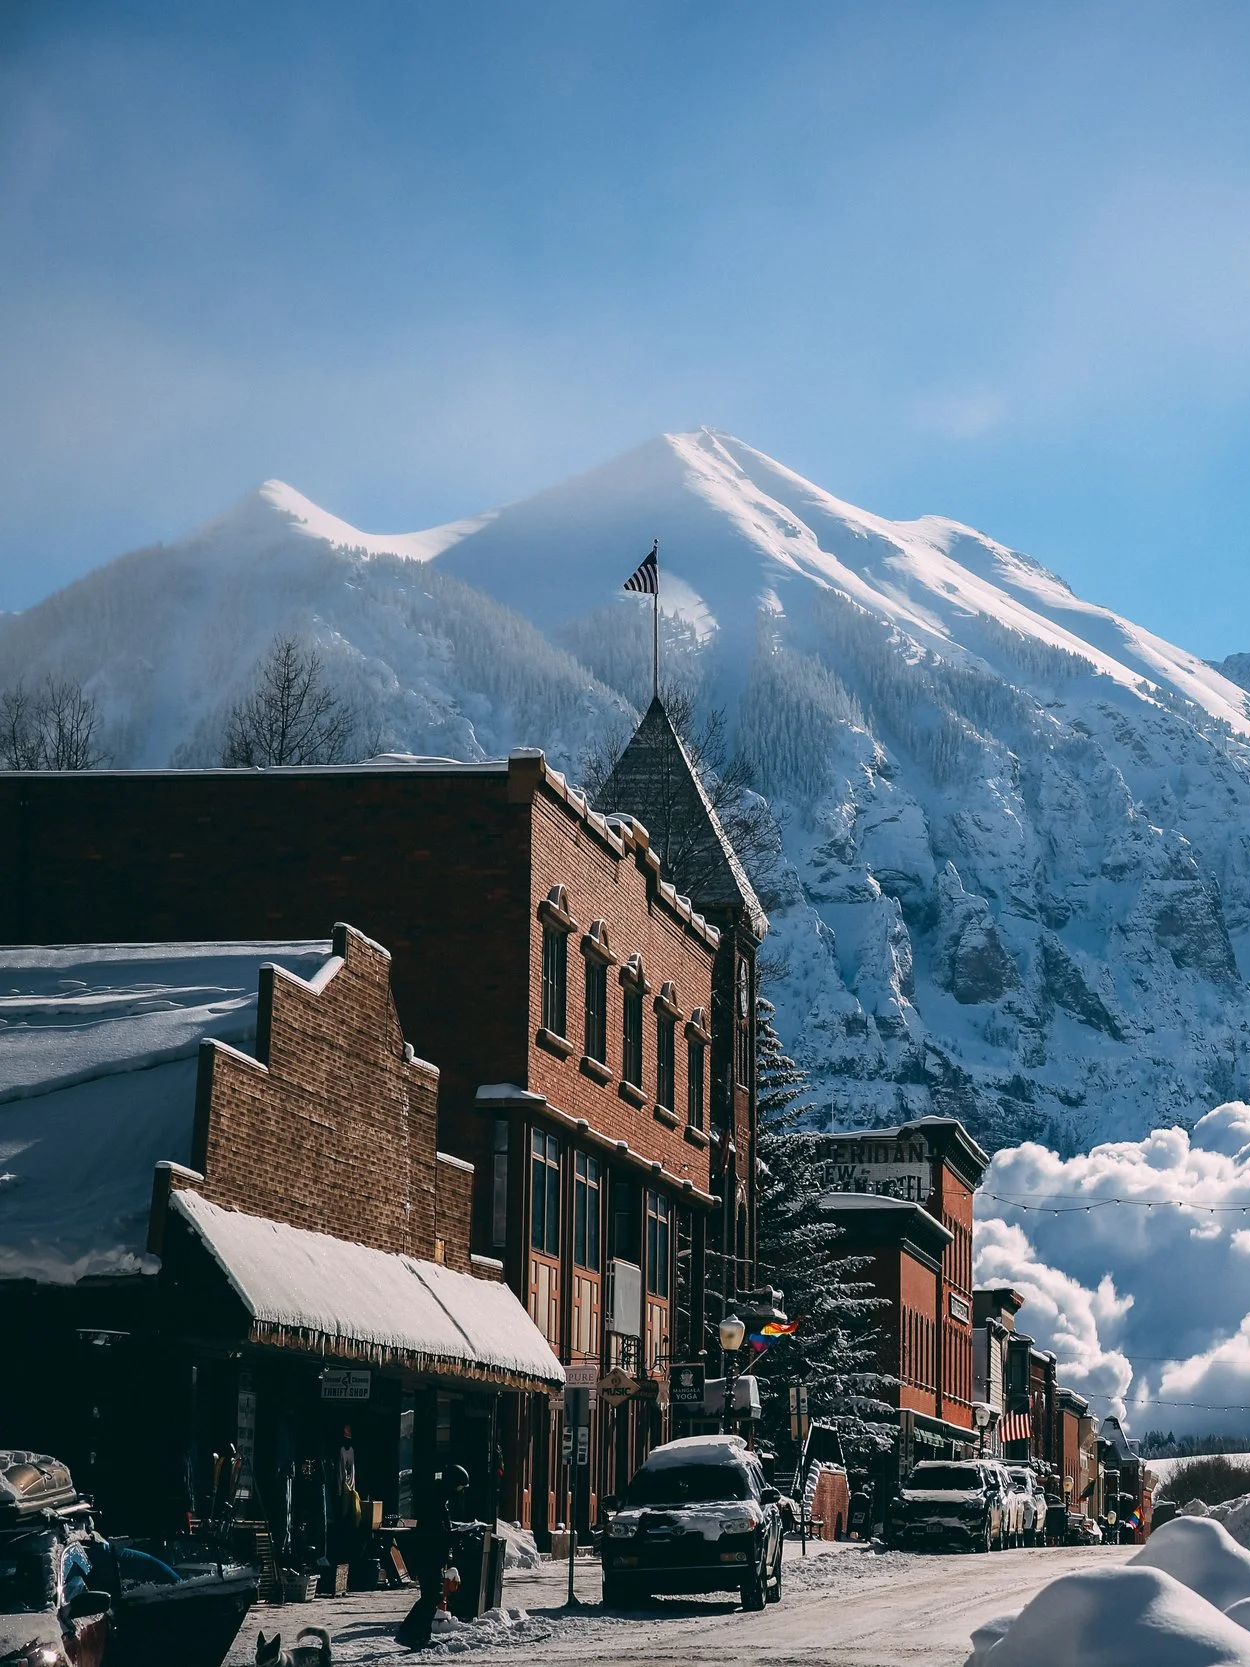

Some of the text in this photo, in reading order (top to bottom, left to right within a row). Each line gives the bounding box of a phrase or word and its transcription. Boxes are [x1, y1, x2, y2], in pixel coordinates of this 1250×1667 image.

[569, 1373, 595, 1381] PURE
[324, 1388, 368, 1397] THRIFT SHOP
[602, 1387, 631, 1397] MUSIC
